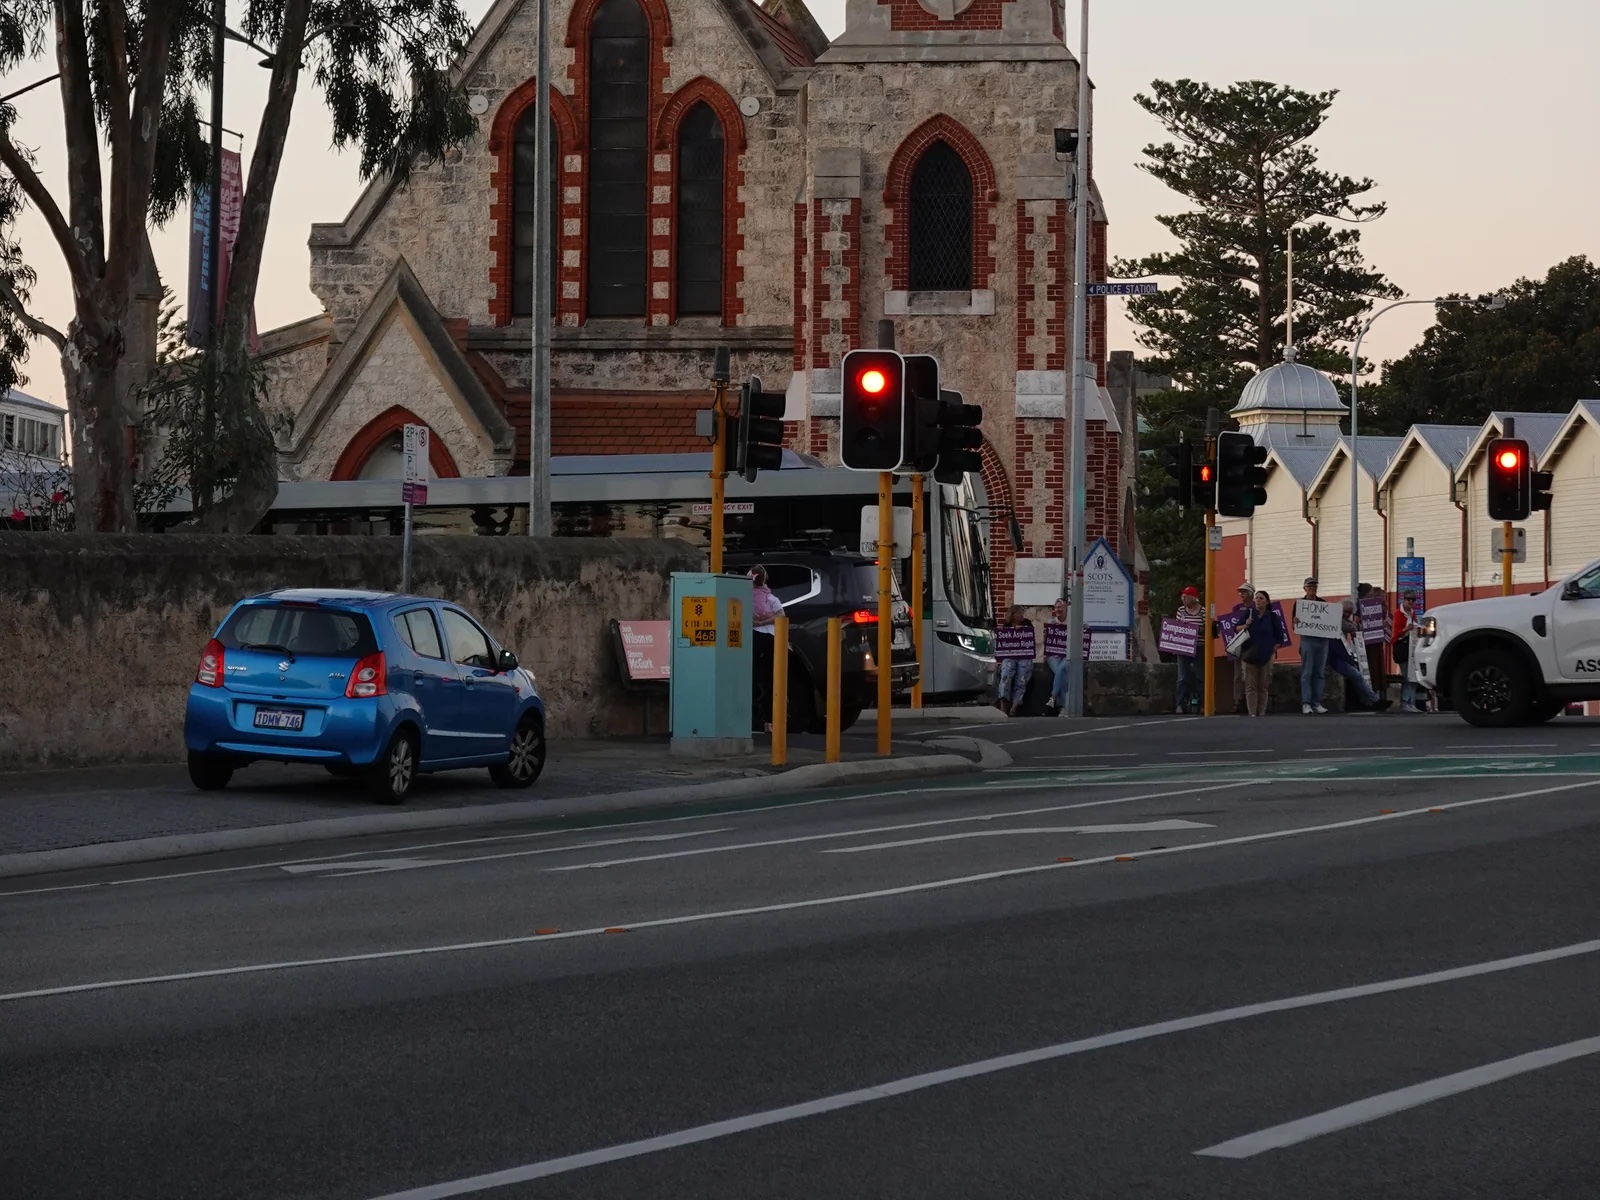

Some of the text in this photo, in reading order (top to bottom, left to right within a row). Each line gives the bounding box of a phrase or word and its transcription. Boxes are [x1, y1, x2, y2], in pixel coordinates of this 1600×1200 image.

[1096, 284, 1156, 294] POLICE STATION
[1301, 602, 1329, 614] HONK
[1162, 621, 1197, 636] Compassion
[1221, 620, 1231, 630] To
[695, 631, 715, 640] 468
[998, 631, 1033, 639] Seek Asylum
[1021, 640, 1034, 648] Right
[1575, 659, 1600, 672] AS
